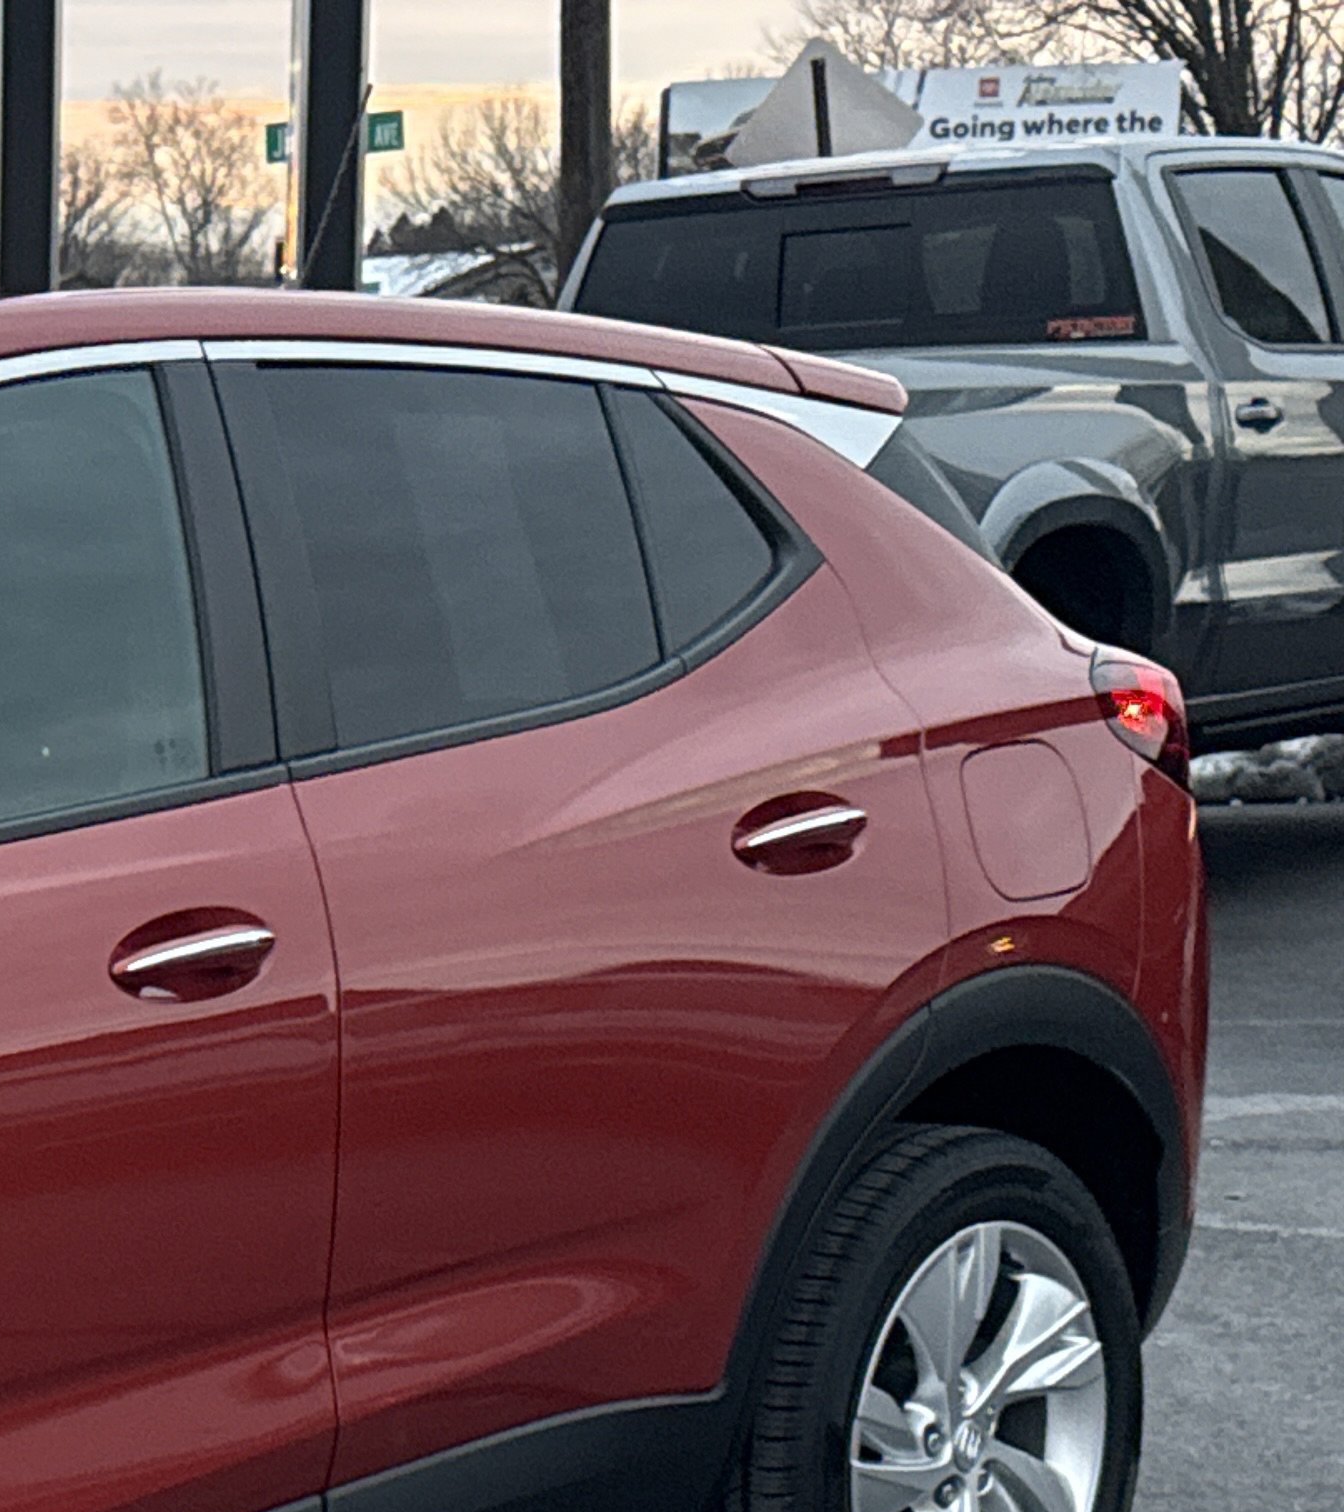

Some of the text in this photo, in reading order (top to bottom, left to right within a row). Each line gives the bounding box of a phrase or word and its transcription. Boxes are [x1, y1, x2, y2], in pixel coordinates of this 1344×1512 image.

[929, 110, 1164, 141] Going where the
